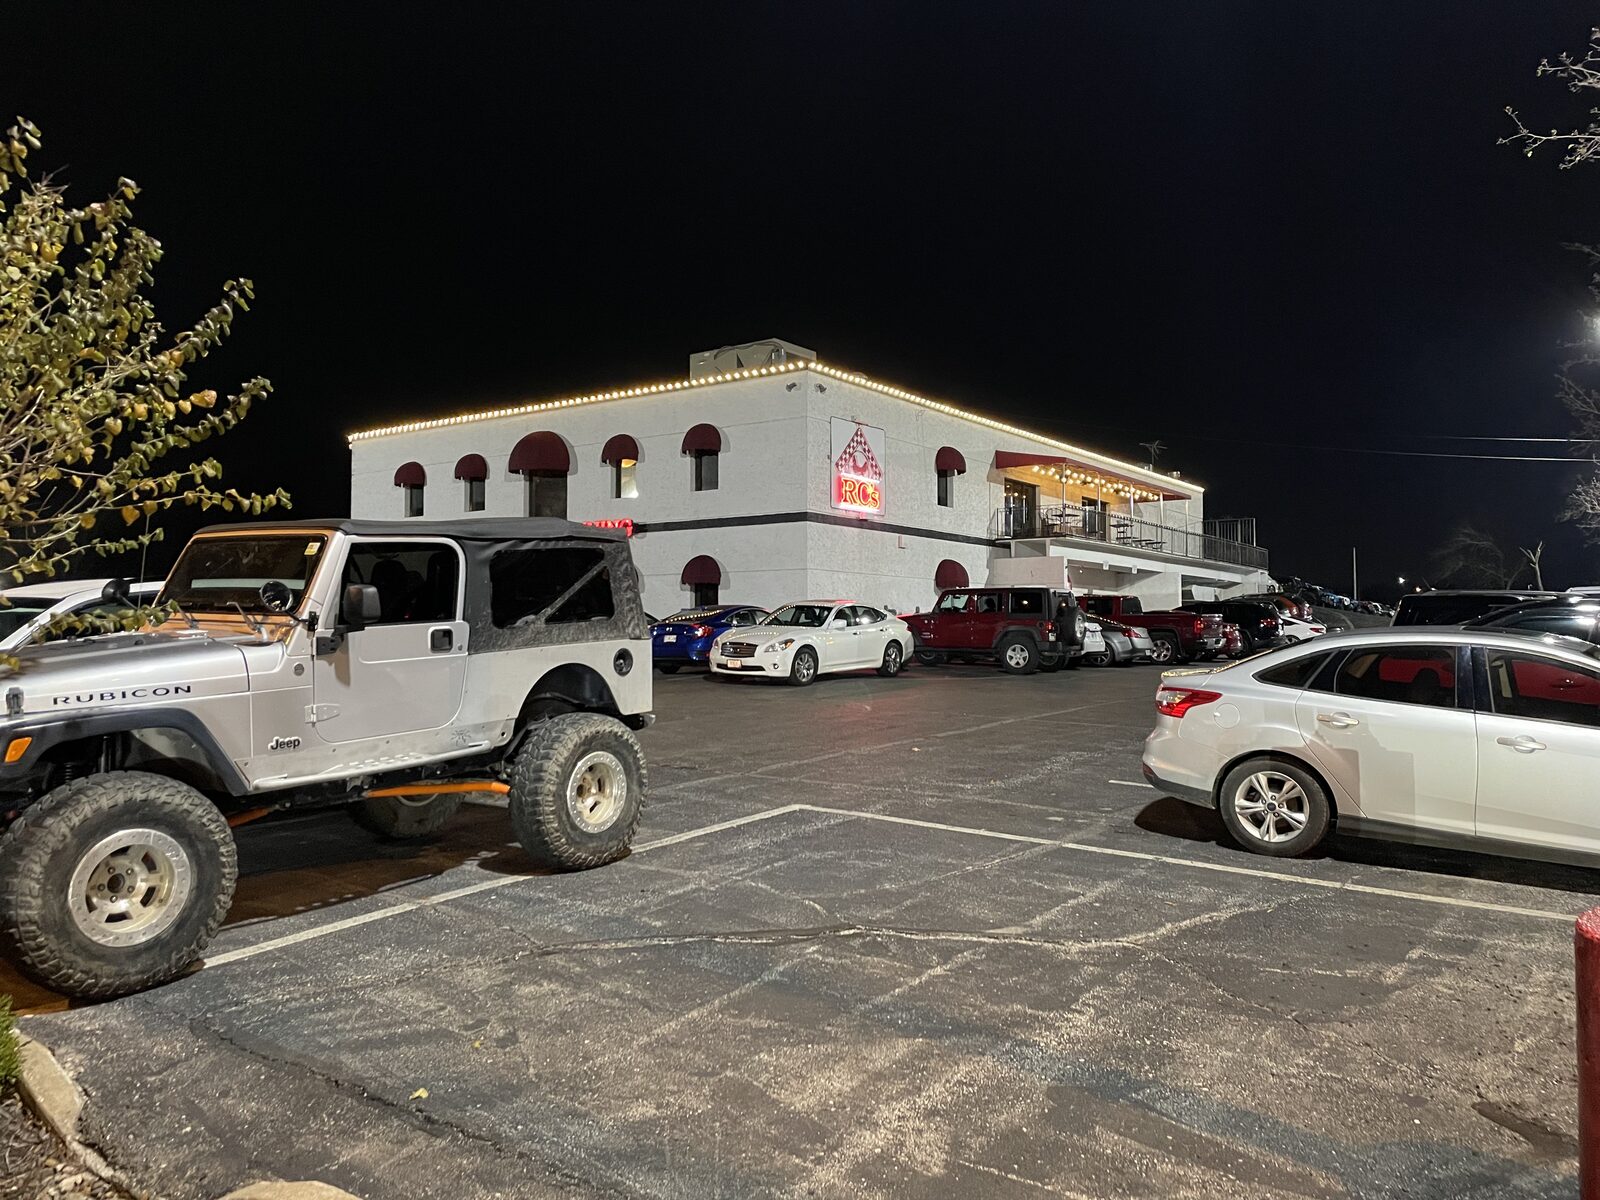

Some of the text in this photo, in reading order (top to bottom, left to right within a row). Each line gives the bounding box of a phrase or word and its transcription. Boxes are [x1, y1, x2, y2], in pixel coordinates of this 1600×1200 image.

[842, 478, 879, 508] RC's
[52, 685, 192, 705] RUBICON
[269, 735, 301, 751] Jeep
